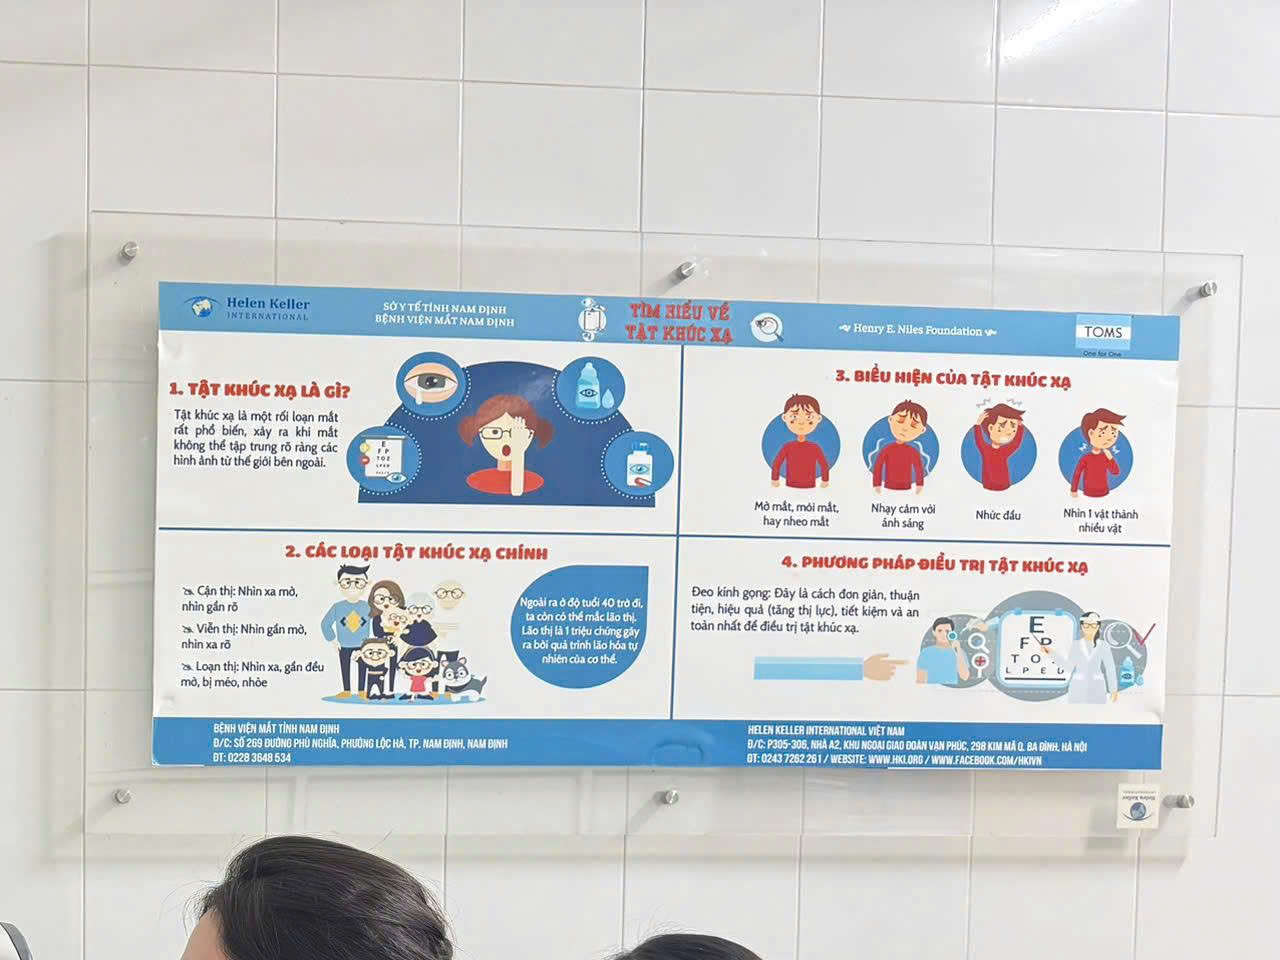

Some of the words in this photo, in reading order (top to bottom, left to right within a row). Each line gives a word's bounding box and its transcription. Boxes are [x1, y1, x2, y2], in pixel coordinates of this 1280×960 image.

[227, 297, 265, 309] Helen
[270, 298, 310, 310] Keller
[227, 312, 309, 321] INTERNATIONAL
[625, 322, 659, 343] TẬT
[663, 323, 706, 342] KHÚC
[710, 327, 733, 345] XẠ
[853, 323, 885, 335] Henry
[886, 324, 896, 334] E.
[898, 324, 924, 335] Niles
[925, 325, 983, 337] Foundation
[1084, 326, 1122, 338] TOMS
[835, 369, 850, 382] 3.
[895, 368, 933, 387] HIỆN
[936, 368, 967, 385] CỦA
[970, 370, 1002, 389] TẬT
[1004, 371, 1048, 388] KHÚC
[1050, 376, 1072, 391] XẠ
[169, 382, 184, 396] 1.
[187, 379, 221, 399] TẬT
[224, 380, 271, 397] KHÚC
[274, 384, 297, 400] XẠ
[301, 381, 320, 398] LÀ
[324, 381, 351, 399] GÌ?
[285, 545, 301, 558] 2.
[305, 542, 337, 558] CÁC
[341, 546, 379, 561] LOẠI
[382, 543, 416, 561] TẬT
[419, 543, 465, 560] KHÚC
[469, 547, 491, 562] XẠ
[495, 543, 548, 560] CHÍNH
[781, 555, 798, 568] 4.
[802, 555, 869, 569] PHƯƠNG
[872, 554, 916, 570] PHÁP
[917, 554, 956, 571] ĐIỀU
[959, 559, 985, 575] TRỊ
[988, 556, 1019, 575] TẬT
[1022, 557, 1064, 573] KHÚC
[1067, 561, 1088, 576] XẠ
[748, 725, 774, 735] HELEN
[775, 725, 805, 735] KELLER
[806, 726, 866, 736] INTERNATIONAL
[868, 724, 885, 737] VIỆT
[887, 726, 905, 736] NAM
[228, 752, 250, 763] 0228
[251, 752, 273, 763] 3648
[274, 752, 291, 763] 534
[761, 753, 783, 764] 0243
